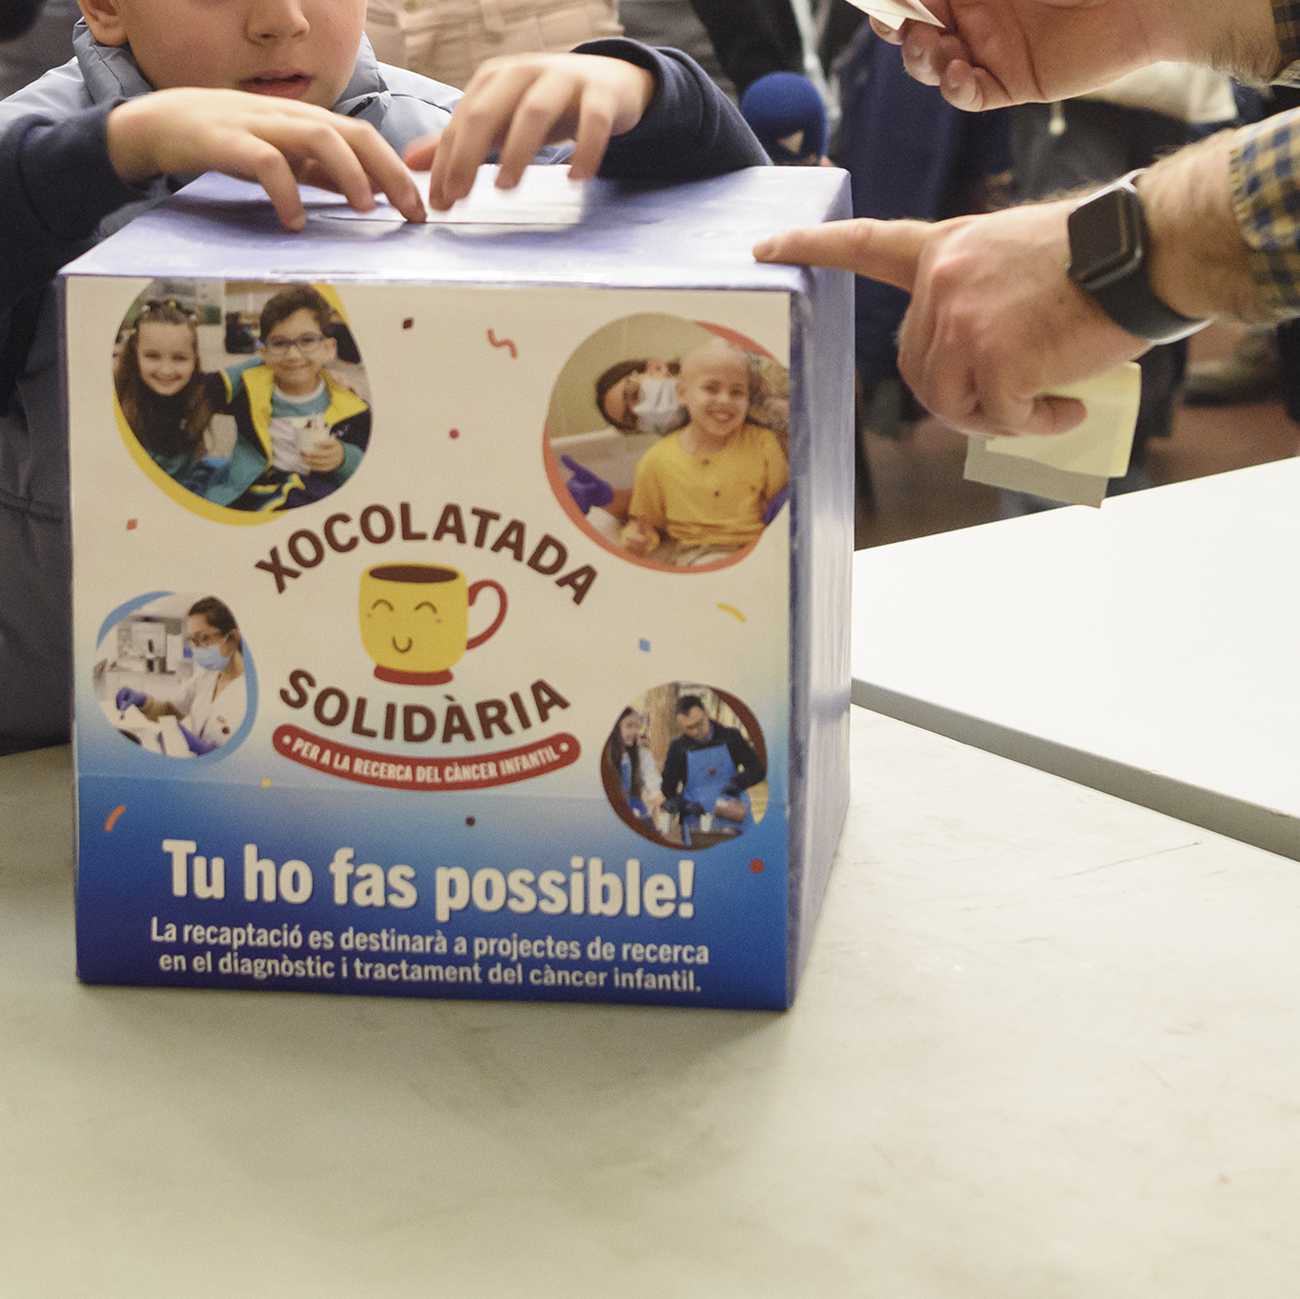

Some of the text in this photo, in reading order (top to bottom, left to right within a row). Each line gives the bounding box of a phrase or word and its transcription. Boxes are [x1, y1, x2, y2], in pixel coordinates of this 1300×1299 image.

[254, 501, 598, 605] XOCOLATADA
[279, 668, 571, 744] SOLIDÀRIA
[291, 737, 561, 783] PER A LA RECERCA DEL CÀNCER INFANTIL
[161, 838, 695, 923] Tu ho fas possible!
[151, 916, 710, 965] La recaptació es destinarà a projectes de recerca
[158, 951, 702, 992] en el diagnòstic i tractament del càncer infantil.
